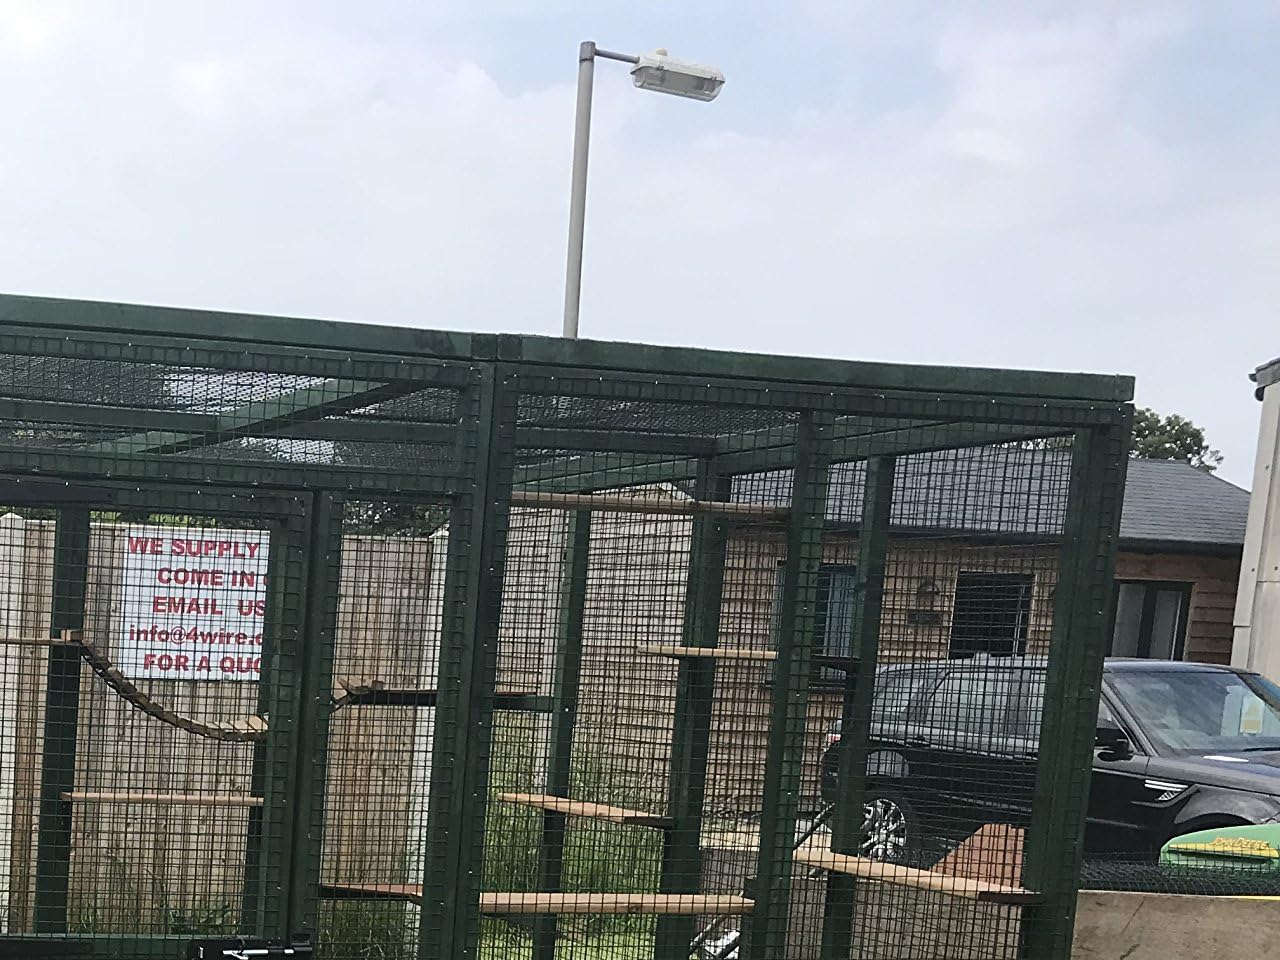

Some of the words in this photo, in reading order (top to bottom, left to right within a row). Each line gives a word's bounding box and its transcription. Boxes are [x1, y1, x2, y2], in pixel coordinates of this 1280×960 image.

[128, 537, 163, 554] WE
[171, 538, 259, 558] SUPPLY
[157, 567, 223, 586] COME
[231, 570, 255, 588] IN
[152, 596, 223, 615] EMAIL
[144, 653, 189, 671] FOR
[196, 655, 212, 673] A
